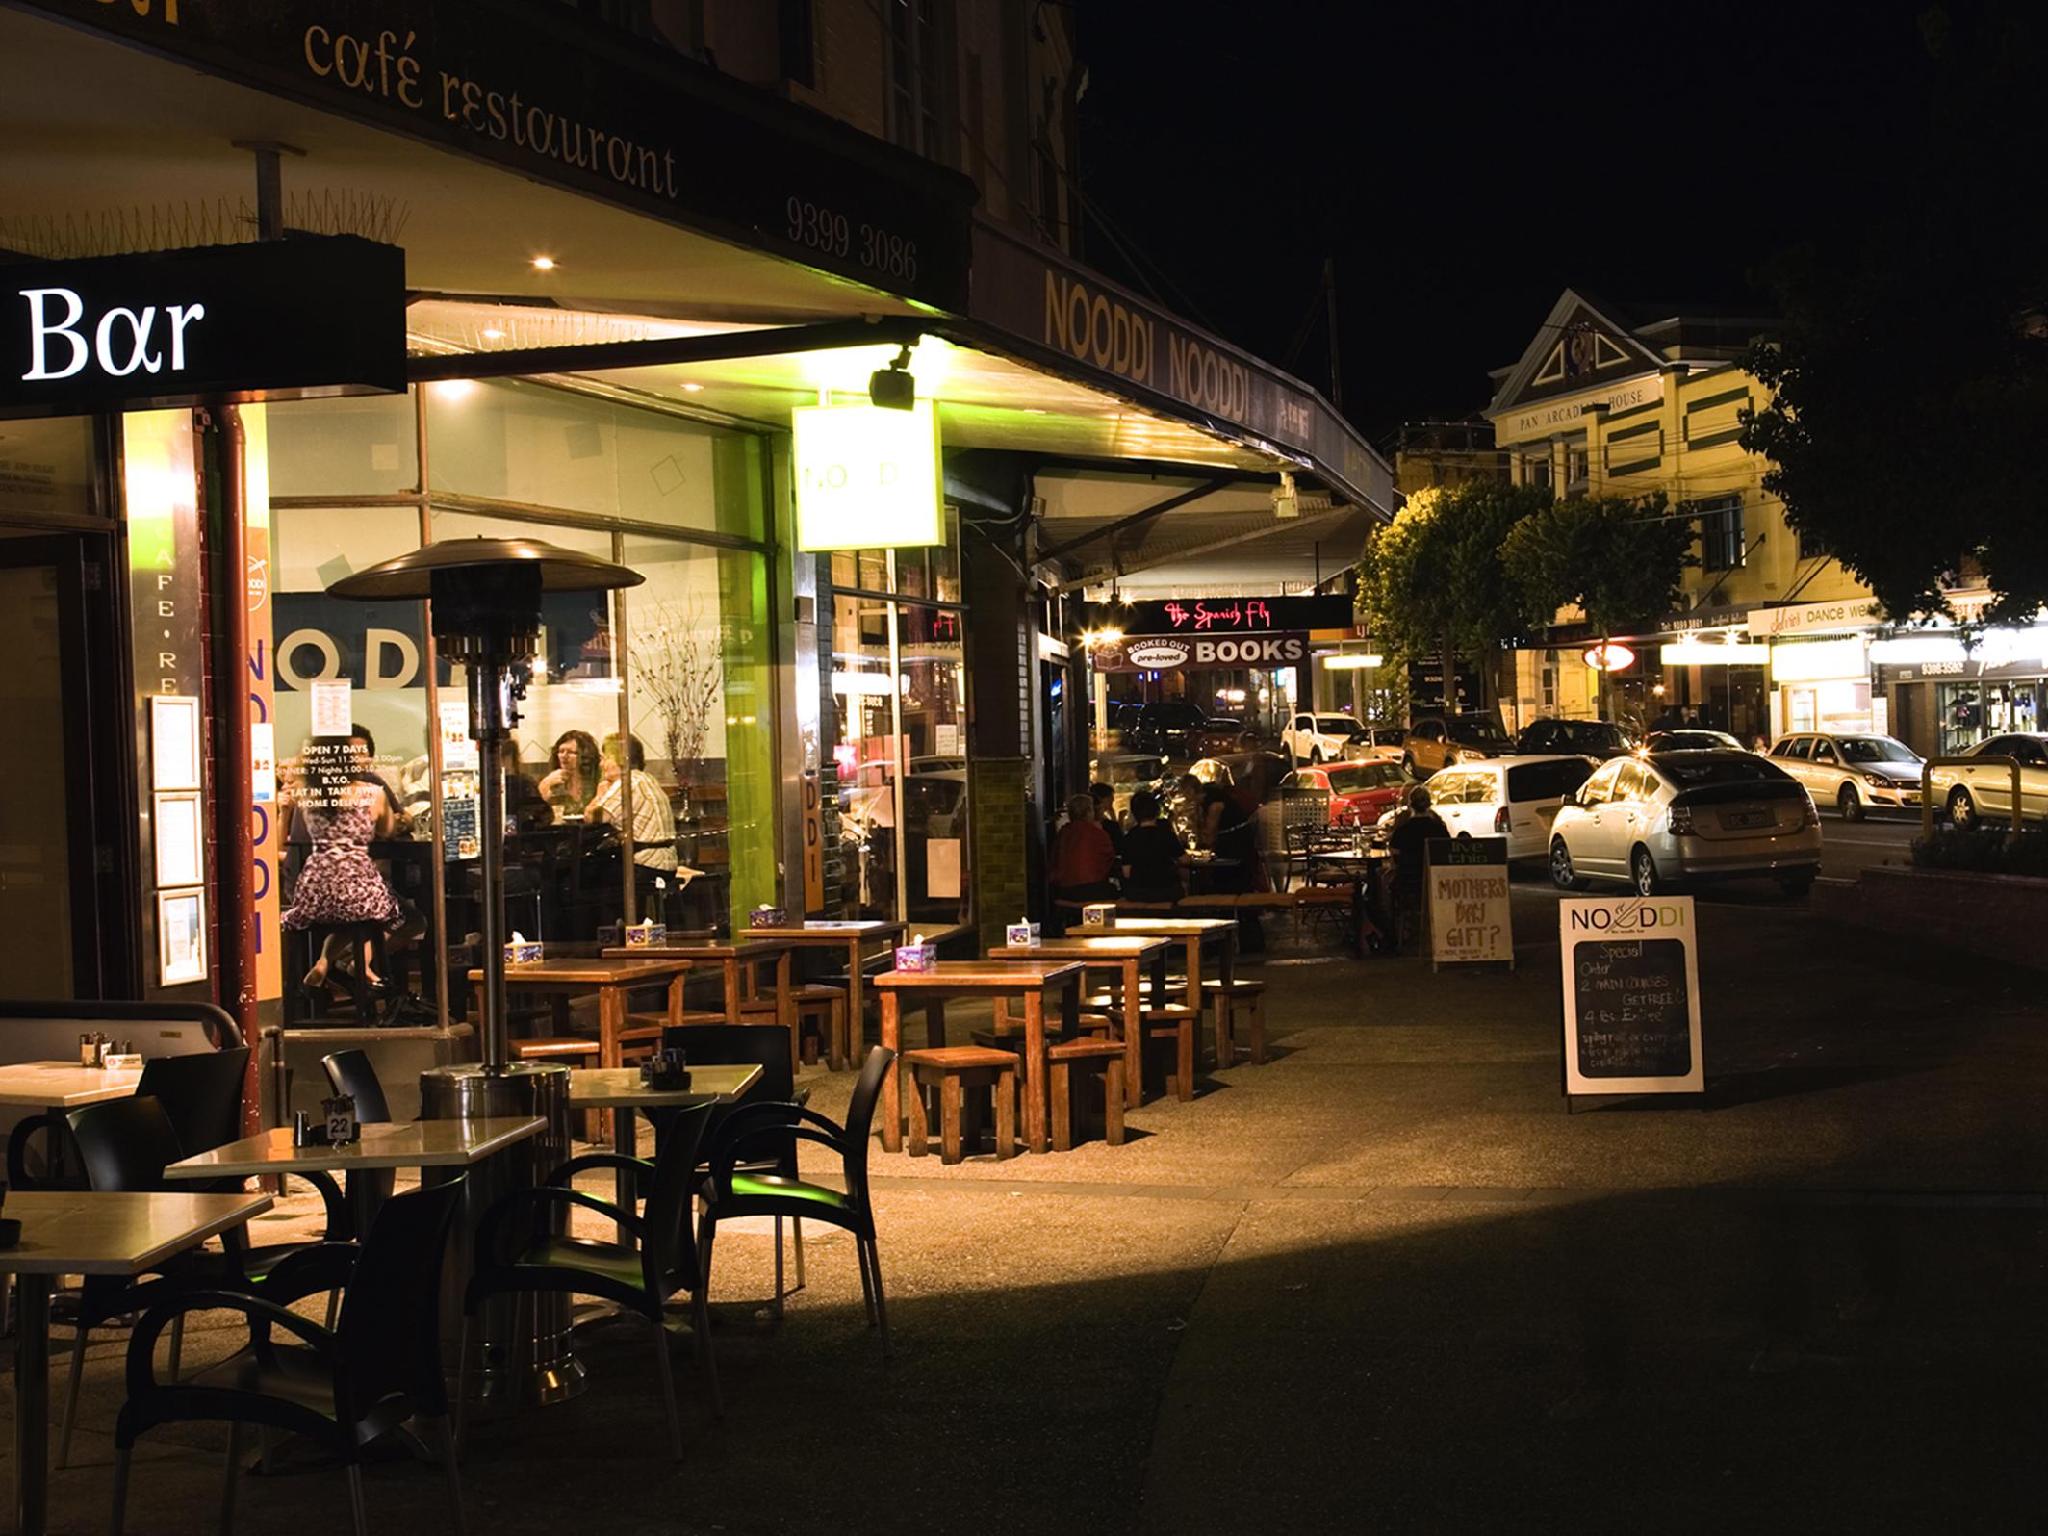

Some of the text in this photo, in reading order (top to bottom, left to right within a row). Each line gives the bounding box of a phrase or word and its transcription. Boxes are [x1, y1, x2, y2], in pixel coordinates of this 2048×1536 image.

[304, 25, 679, 199] café restaurant
[785, 196, 917, 282] 9399 3086
[19, 287, 205, 382] Bar
[1043, 269, 1249, 423] NOODDI NOODDI
[1520, 415, 1538, 431] PAN
[1608, 390, 1643, 409] HOUSE
[1193, 603, 1242, 630] Spanish
[1244, 602, 1271, 628] Fly
[1126, 639, 1191, 654] BOOKED OUT
[1196, 639, 1302, 663] BOOKS
[303, 744, 369, 756] OPEN 7 DAYS
[310, 766, 316, 774] 7
[318, 765, 343, 777] Nights
[310, 787, 322, 796] IN
[327, 787, 352, 796] TAKE
[1438, 878, 1507, 900] MOTHERS
[1580, 979, 1591, 992] 2
[330, 1118, 349, 1133] 22
